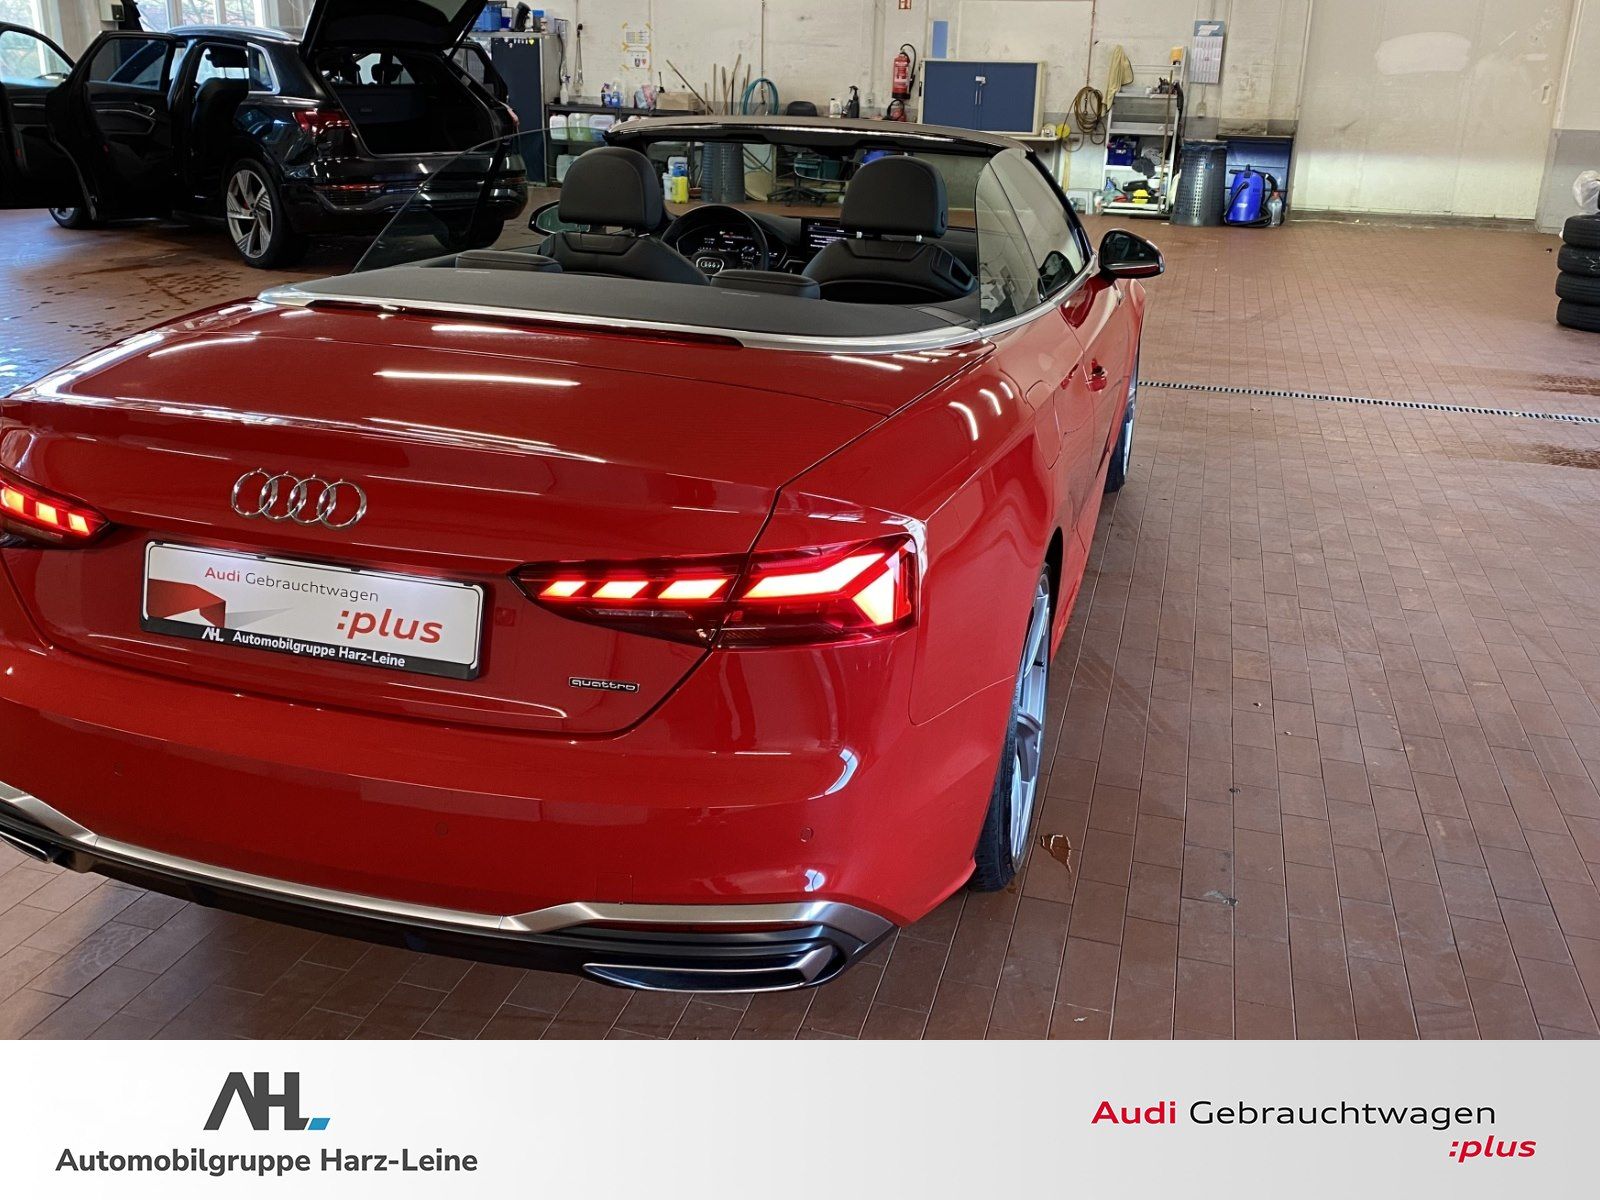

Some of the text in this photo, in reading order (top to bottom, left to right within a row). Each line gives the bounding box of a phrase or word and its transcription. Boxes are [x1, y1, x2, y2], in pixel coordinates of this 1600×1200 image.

[204, 566, 379, 602] Audi Gebrauchtwagen
[336, 608, 443, 644] :plus
[232, 630, 336, 657] Automobilgruppe
[338, 646, 406, 667] Harz-Leine
[571, 679, 636, 691] quattro
